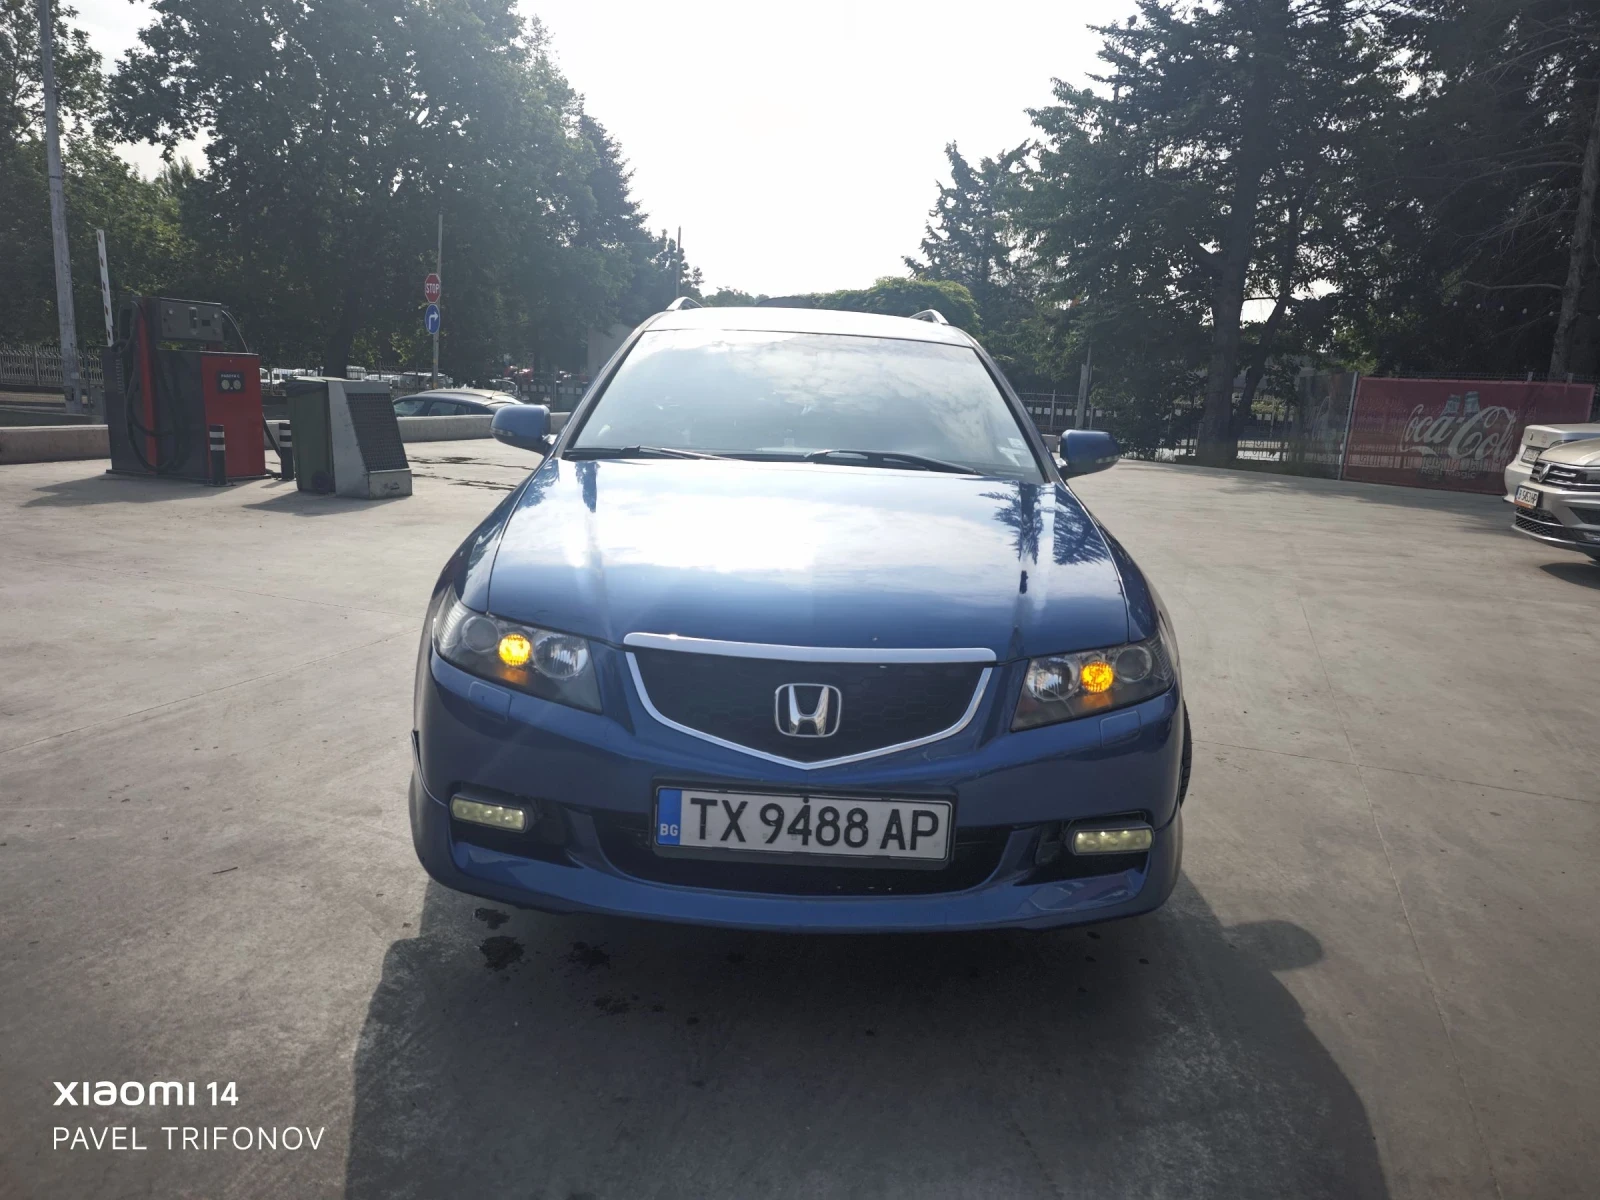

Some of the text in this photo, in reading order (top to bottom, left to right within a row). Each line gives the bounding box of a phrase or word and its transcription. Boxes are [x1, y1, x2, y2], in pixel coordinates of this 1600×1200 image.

[426, 283, 439, 294] STOP
[1445, 469, 1477, 480] Magic
[659, 823, 679, 836] BG
[690, 797, 939, 851] TX 9488 AP
